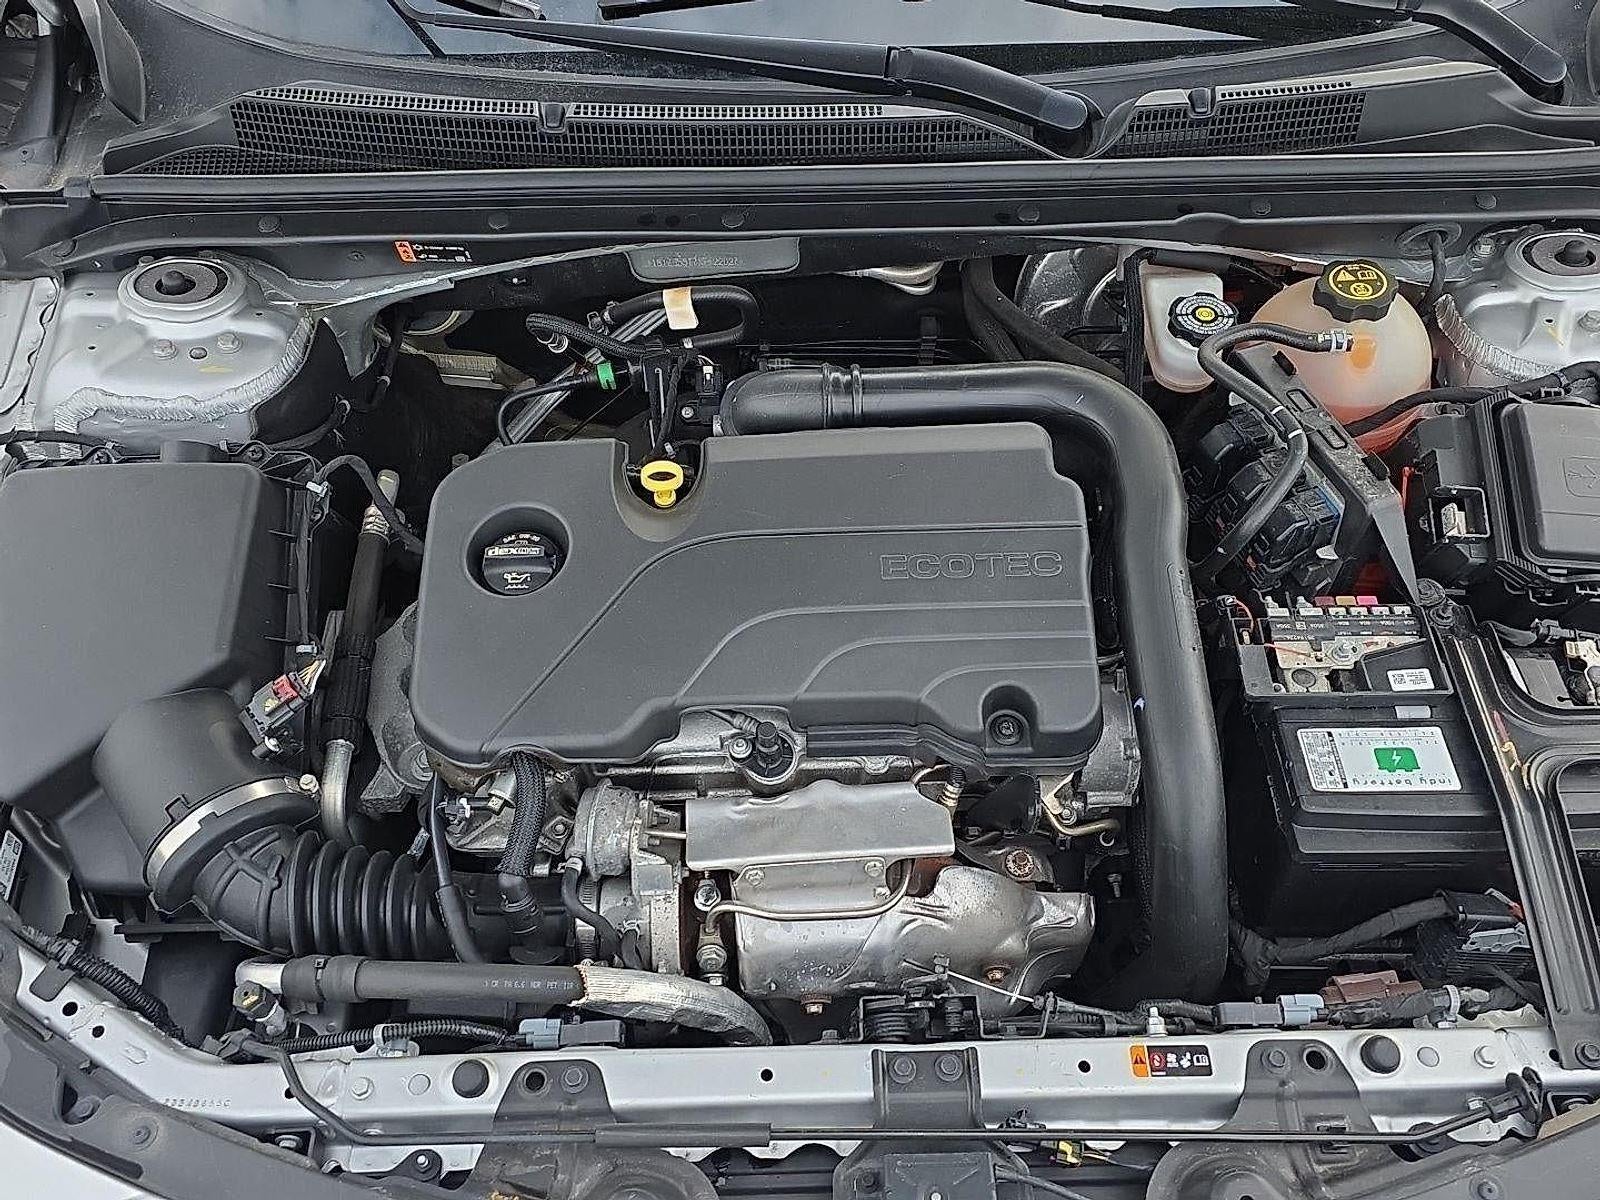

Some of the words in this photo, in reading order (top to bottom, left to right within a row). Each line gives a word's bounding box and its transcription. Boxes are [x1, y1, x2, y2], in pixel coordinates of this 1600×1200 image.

[487, 546, 540, 556] dexos
[880, 551, 1063, 580] ECOTEC
[1352, 777, 1413, 787] battery
[1418, 777, 1452, 787] indy
